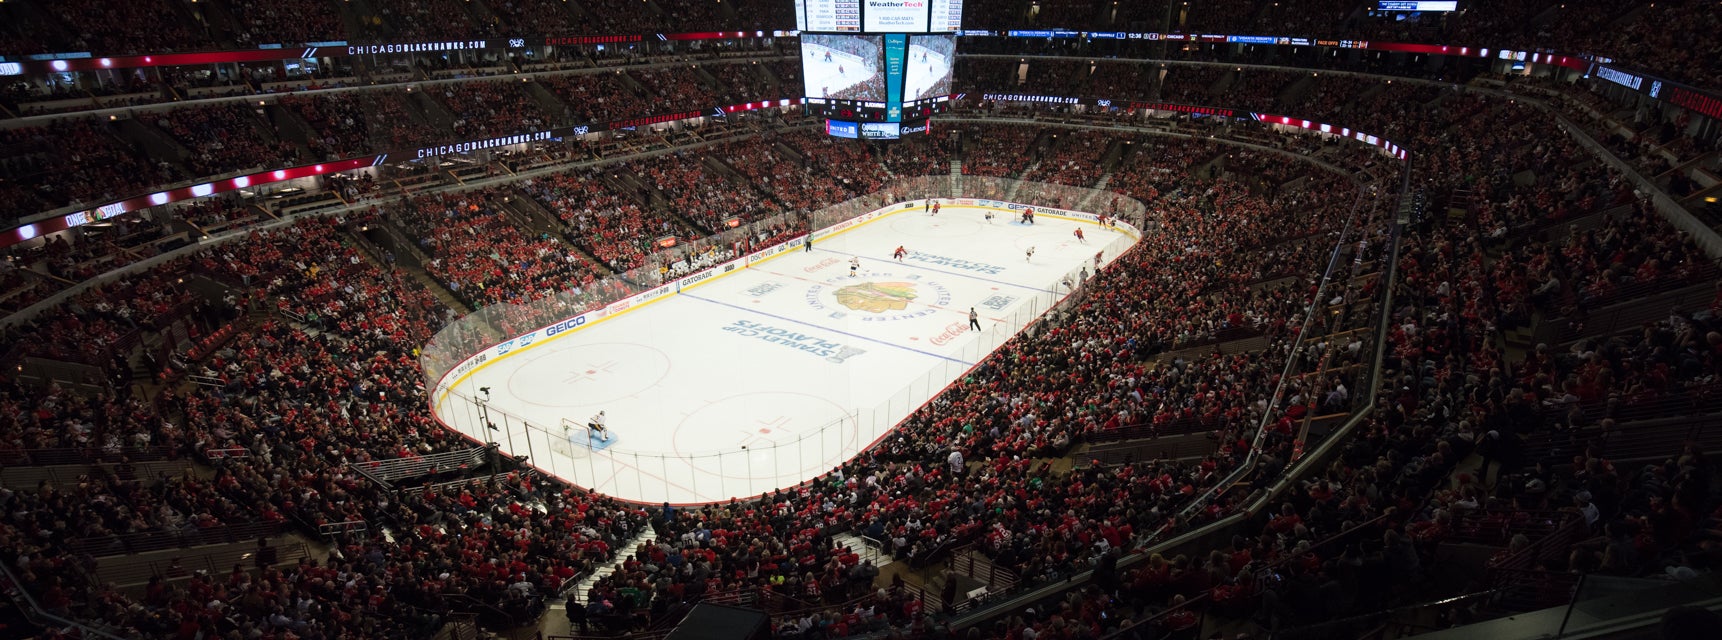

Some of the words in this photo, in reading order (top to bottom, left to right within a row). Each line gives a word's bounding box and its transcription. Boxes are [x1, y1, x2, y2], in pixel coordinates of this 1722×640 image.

[348, 40, 486, 55] CHICAGOBLACKHAWKS.COM
[983, 93, 1079, 104] CHICAGOBLACKHAWKS.COM
[417, 131, 552, 158] CHICAGOBLACKHAWKS.COM
[65, 211, 86, 228] ONE
[1037, 207, 1067, 216] GATORADE
[750, 248, 774, 262] DISCOVER
[682, 270, 713, 287] GATORADE
[806, 285, 824, 310] UNITED
[928, 281, 951, 306] UNITED
[862, 308, 936, 322] CENTER
[546, 315, 586, 337] GEICO
[722, 326, 759, 337] CUP
[732, 319, 841, 349] PLAYOFFS
[755, 335, 836, 357] STANLEY
